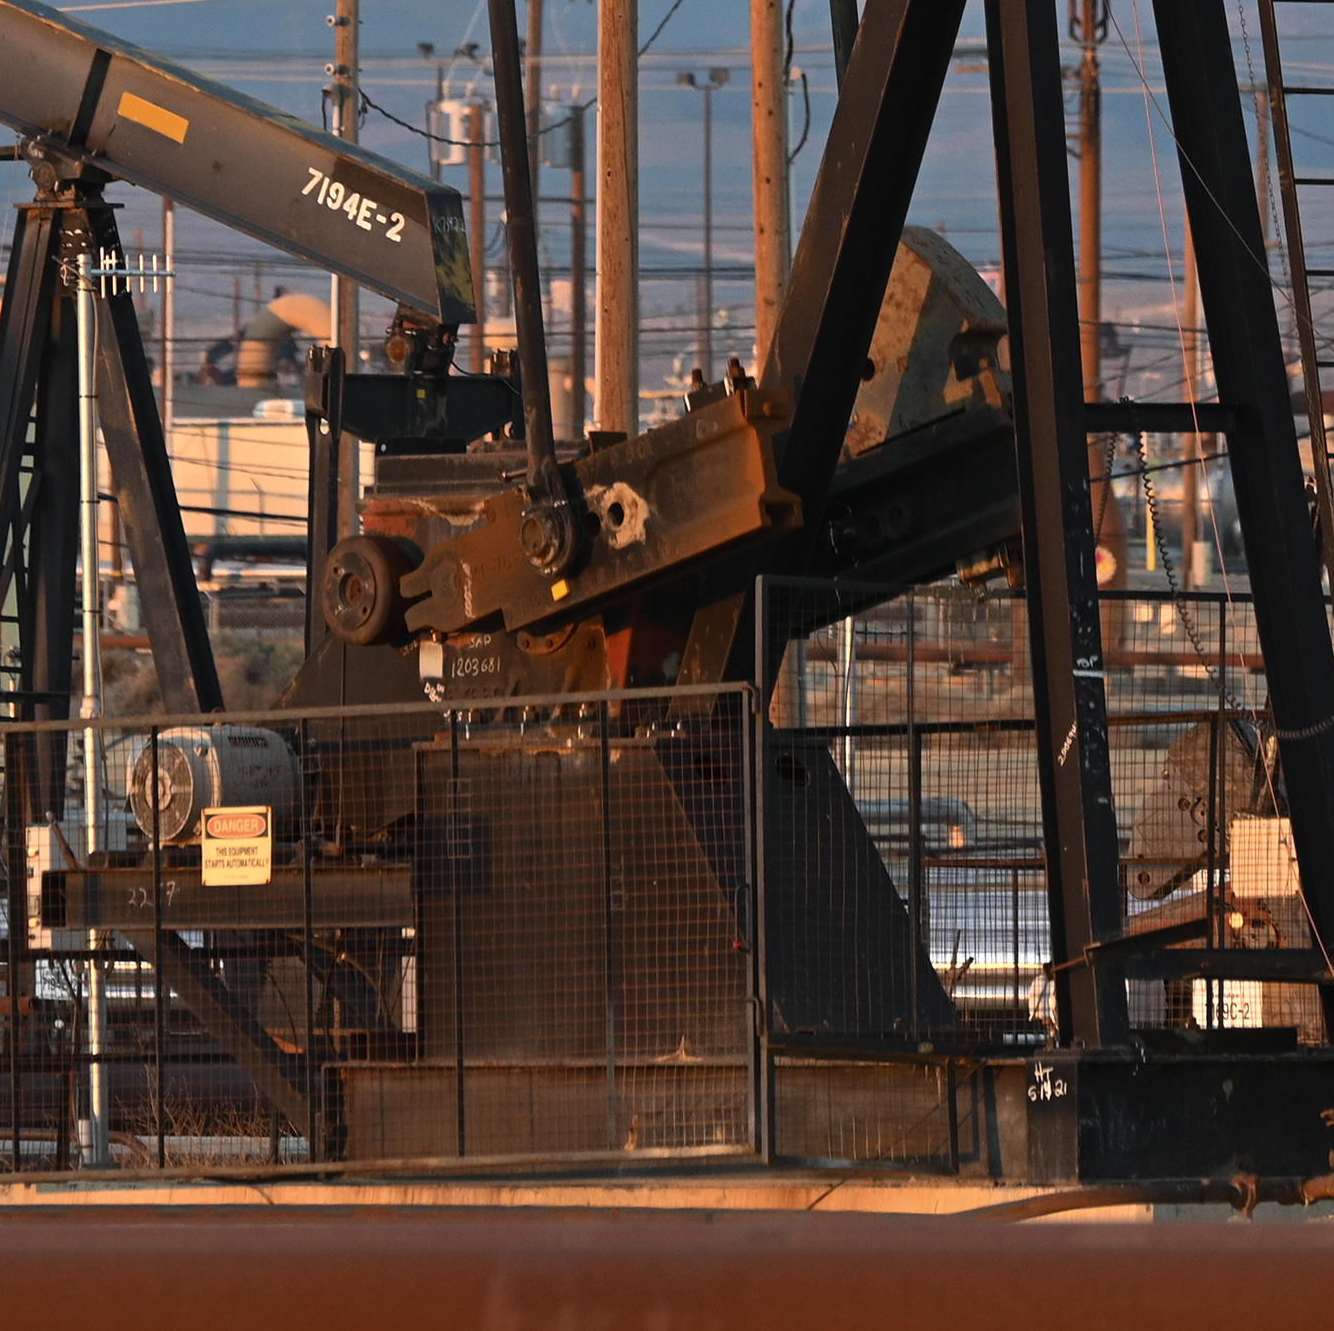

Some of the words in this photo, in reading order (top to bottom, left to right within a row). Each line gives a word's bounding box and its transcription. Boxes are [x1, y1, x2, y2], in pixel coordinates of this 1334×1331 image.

[301, 167, 406, 243] 7194E-2
[470, 634, 491, 649] SAP
[452, 656, 501, 679] 1203681
[214, 819, 258, 833] DANGER
[216, 847, 227, 857] THIS
[228, 846, 258, 856] EQUIPMENT
[204, 859, 225, 869] STARTS
[227, 858, 269, 869] AUTOMATICALLY
